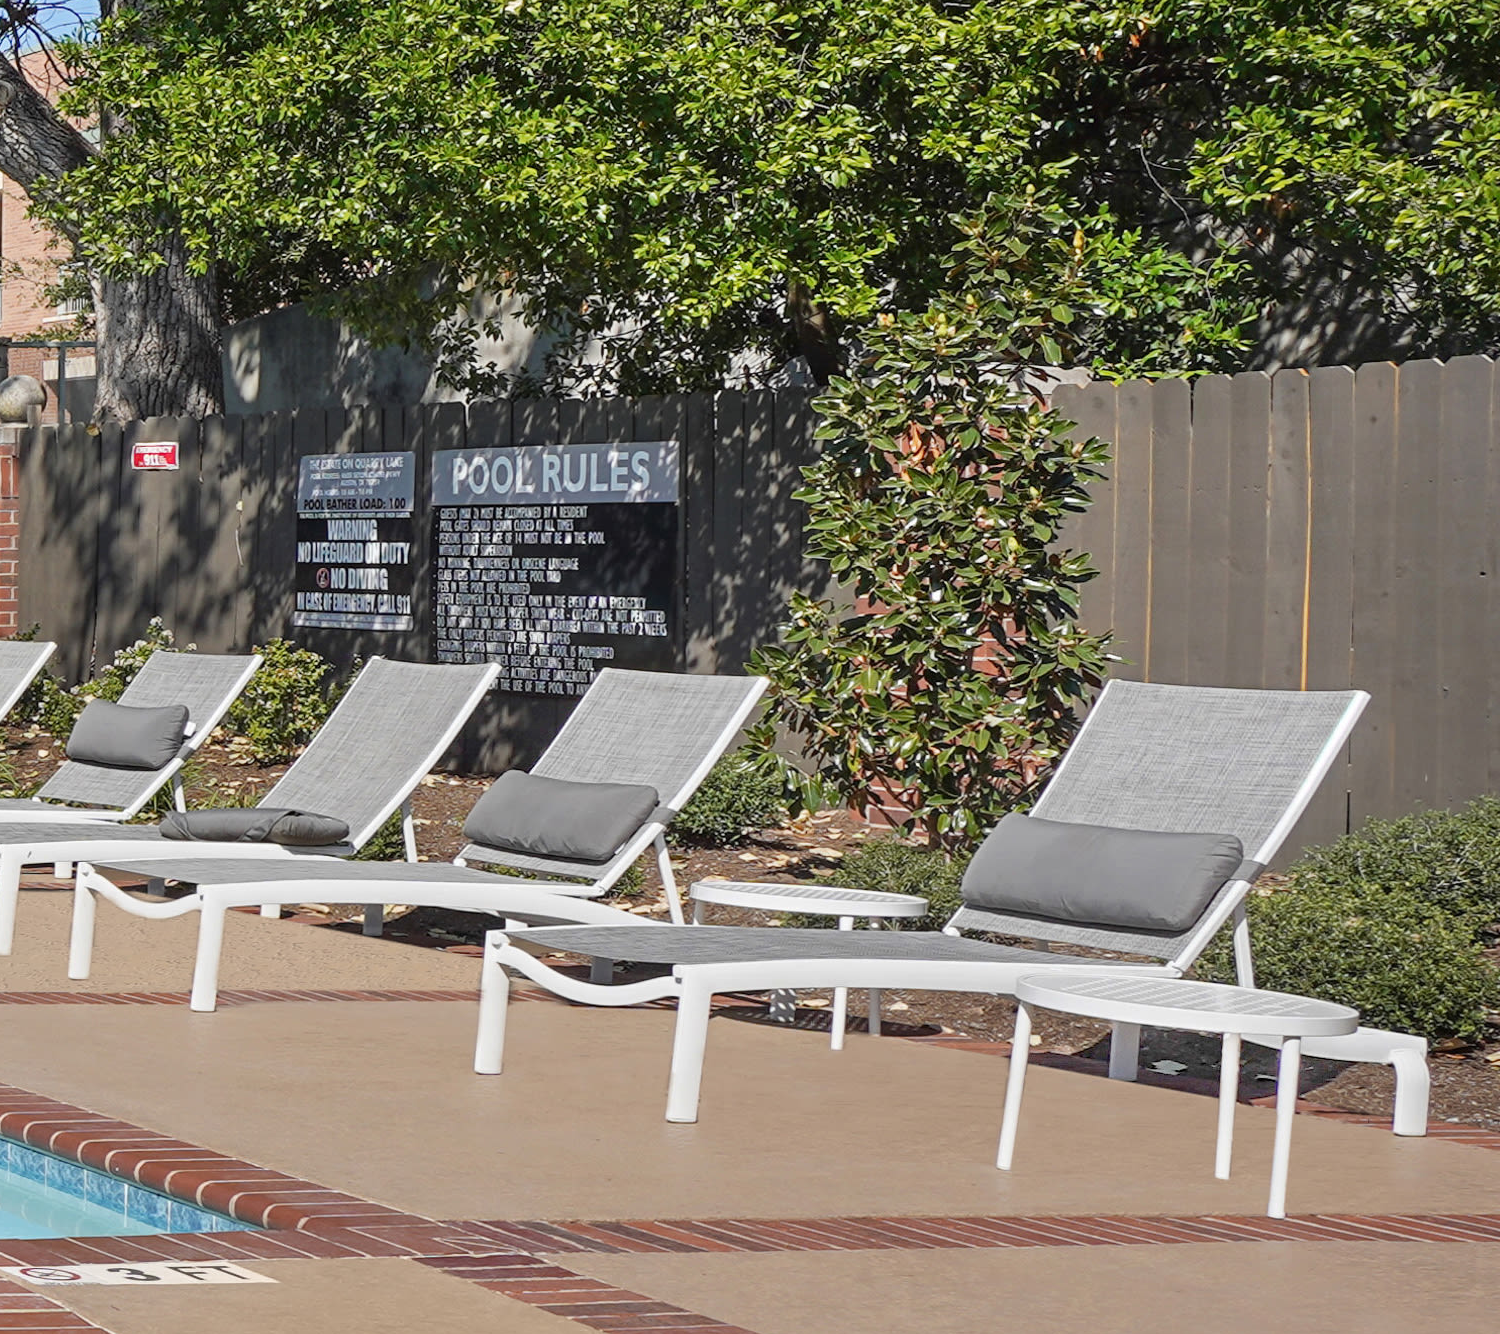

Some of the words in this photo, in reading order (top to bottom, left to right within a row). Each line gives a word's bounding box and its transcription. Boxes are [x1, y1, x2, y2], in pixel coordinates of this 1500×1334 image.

[143, 454, 159, 466] 911
[342, 458, 354, 469] ON
[386, 456, 404, 468] LAKE
[452, 455, 534, 495] POOL
[542, 451, 650, 493] RULES
[303, 499, 324, 510] POOL
[326, 498, 357, 510] BATHER
[359, 498, 386, 509] LOAD:
[390, 498, 406, 509] 100
[496, 507, 503, 519] BE
[544, 507, 551, 518] BY
[560, 506, 588, 518] RESIDENT
[327, 519, 378, 541] WARNING
[440, 520, 452, 532] POOL
[514, 519, 535, 531] CLOSED
[536, 519, 543, 531] AT
[544, 519, 555, 531] ALL
[481, 532, 491, 544] THE
[505, 532, 512, 544] OF
[541, 532, 552, 544] NOT
[554, 532, 562, 544] BE
[574, 532, 586, 544] THE
[588, 532, 605, 544] POOL
[297, 541, 312, 563] NO
[312, 542, 364, 563] LIFEGUARD
[365, 542, 380, 564] ON
[381, 542, 410, 564] DUTY
[548, 558, 579, 570] LANGUAGE
[330, 568, 346, 589] NO
[348, 568, 388, 590] DIVING
[508, 570, 515, 581] IN
[517, 570, 528, 582] THE
[530, 571, 545, 582] POOL
[297, 592, 305, 610] IN
[306, 592, 323, 610] CASE
[323, 593, 332, 611] OF
[378, 594, 396, 613] CALL
[397, 595, 411, 614] 911
[503, 594, 511, 606] BE
[512, 595, 526, 607] USED
[545, 595, 552, 607] IN
[554, 595, 566, 607] THE
[568, 596, 586, 608] EVENT
[588, 596, 597, 608] OF
[598, 596, 607, 609] AN
[548, 608, 565, 620] WEAR
[572, 609, 599, 621] CUT-OFFS
[601, 609, 613, 621] ARE
[615, 610, 628, 622] NOT
[631, 610, 666, 623] PERMITTED
[607, 622, 619, 634] THE
[621, 623, 636, 635] PAST
[637, 624, 644, 635] 2
[645, 624, 668, 636] WEEKS
[538, 644, 550, 656] THE
[552, 645, 568, 657] POOL
[578, 646, 614, 659] PROHIBITED
[533, 656, 562, 669] ENTERING
[564, 658, 576, 669] THE
[578, 659, 594, 671] POOL
[540, 669, 551, 681] ARE
[553, 669, 588, 682] DANGEROUS
[513, 680, 523, 691] USE
[525, 681, 533, 692] OF
[535, 681, 546, 693] THE
[548, 682, 564, 694] POOL
[566, 683, 575, 695] TO
[107, 1267, 161, 1282] 3
[165, 1265, 250, 1280] FT
